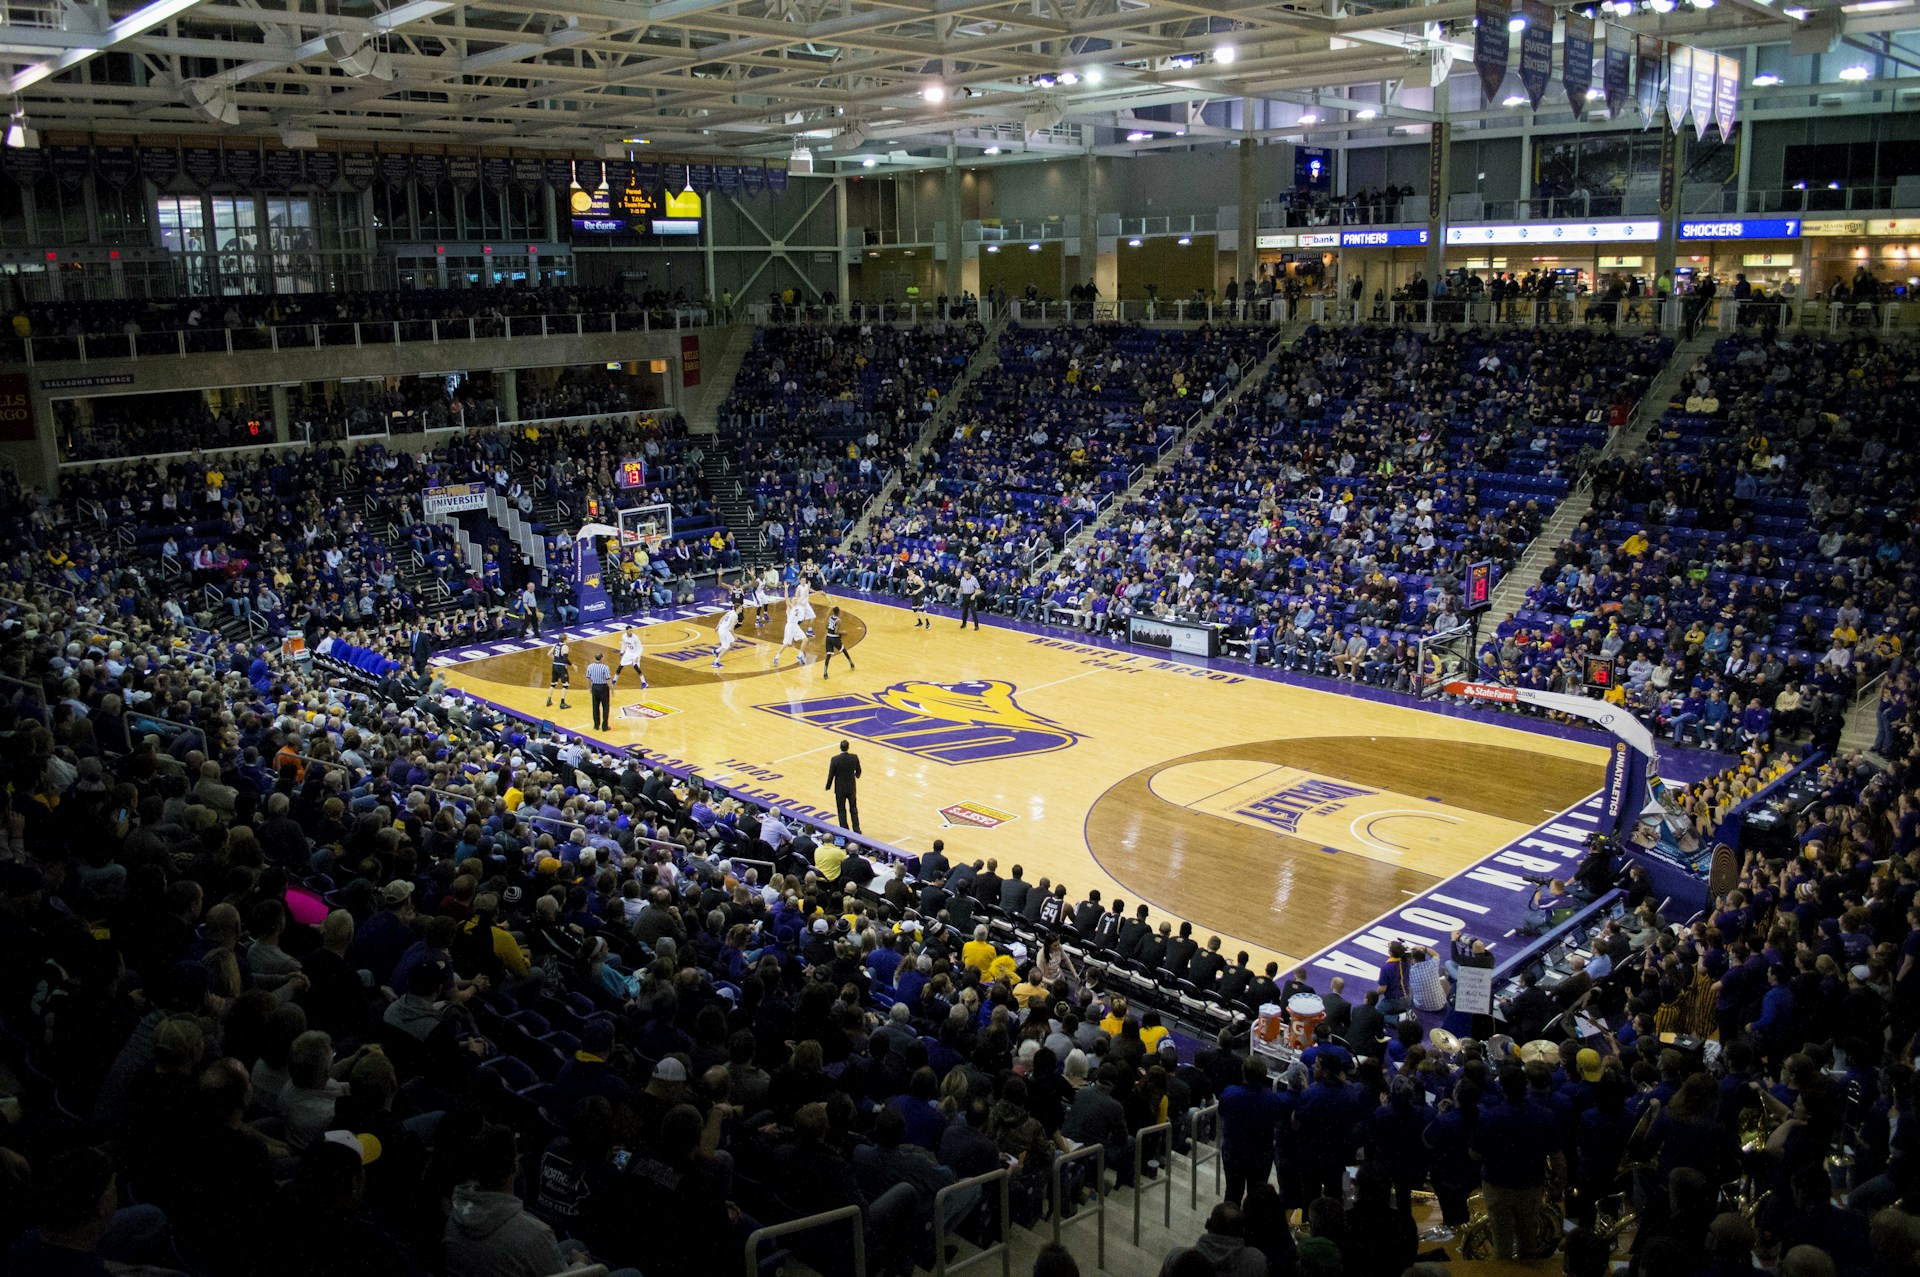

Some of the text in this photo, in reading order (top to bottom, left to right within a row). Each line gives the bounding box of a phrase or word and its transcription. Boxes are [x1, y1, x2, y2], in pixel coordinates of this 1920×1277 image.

[1524, 39, 1551, 56] SWEET
[1524, 55, 1550, 74] SIXTEEN
[584, 221, 616, 233] The Gazette
[1683, 222, 1743, 238] SHOCKERS
[1786, 222, 1795, 235] 7
[1343, 232, 1427, 245] PANTHERS 5
[44, 376, 132, 388] GALLAGHER TERRACE
[426, 494, 485, 514] UNIVERSITY
[1029, 637, 1120, 660] Robert
[1150, 660, 1246, 686] McCoy
[1080, 659, 1145, 675] Court
[1608, 742, 1627, 817] @UNIATHLETICS
[1235, 778, 1380, 834] VALLEY
[1040, 906, 1059, 924] 24
[1312, 892, 1492, 982] IOWA
[1292, 1020, 1305, 1036] G
